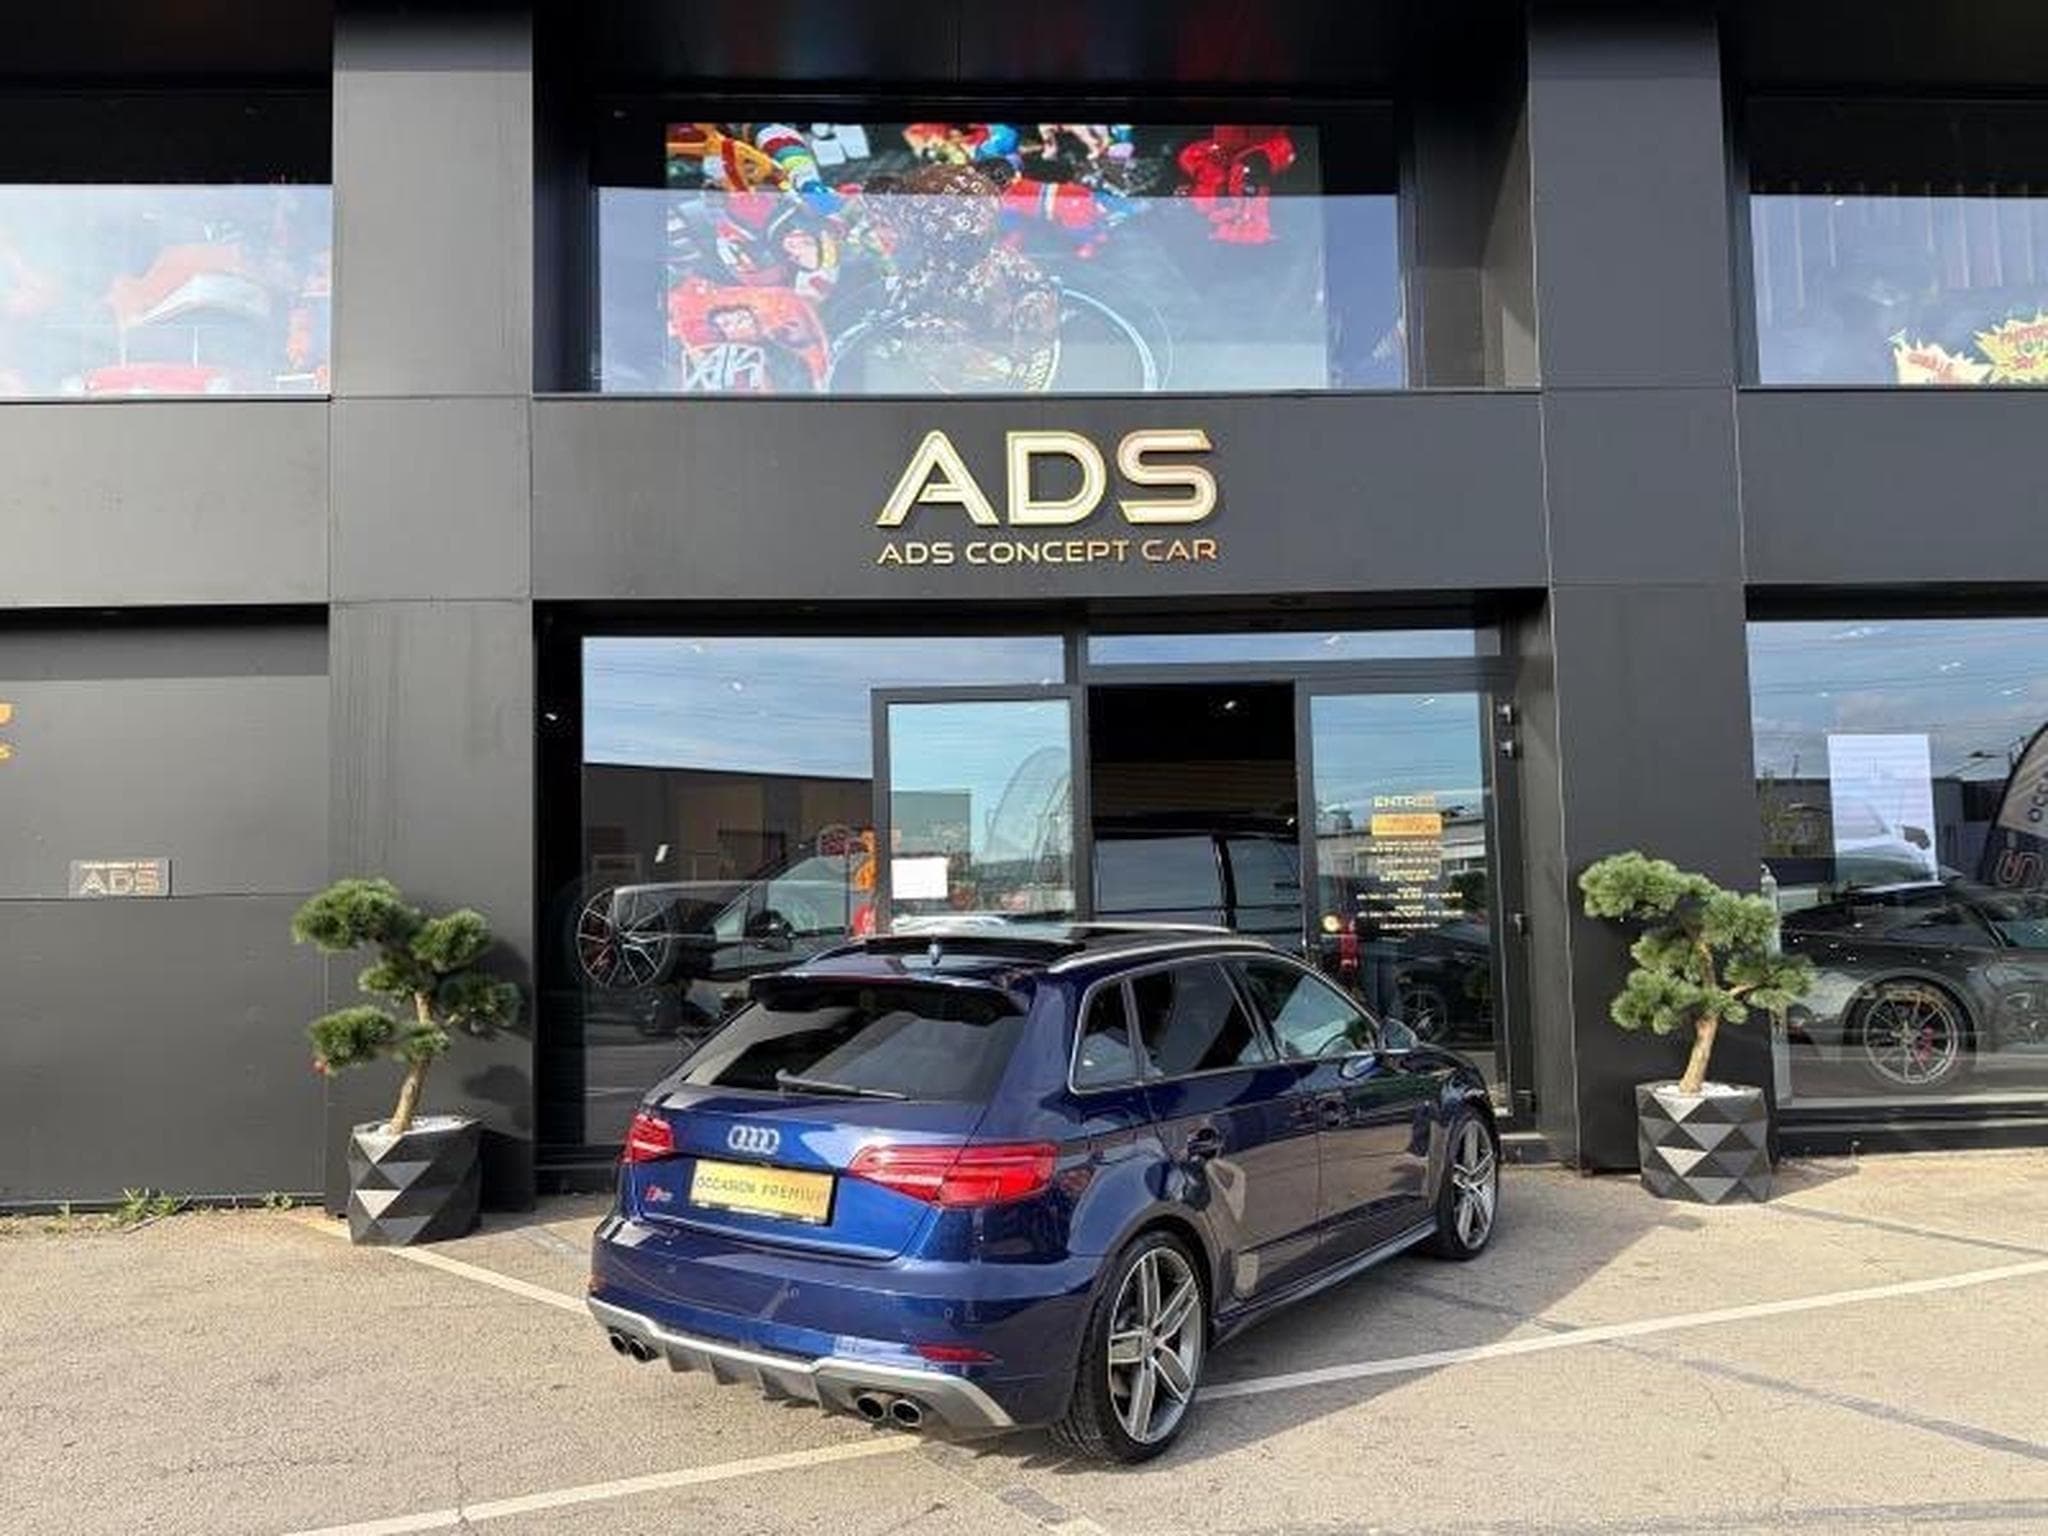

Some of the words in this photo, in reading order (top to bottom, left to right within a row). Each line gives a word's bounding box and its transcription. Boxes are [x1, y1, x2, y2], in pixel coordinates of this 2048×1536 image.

[876, 430, 1218, 527] ADS
[877, 542, 954, 564] ADS
[966, 540, 1129, 563] CONCEPT
[1141, 539, 1217, 562] CAR
[80, 869, 160, 895] ADS
